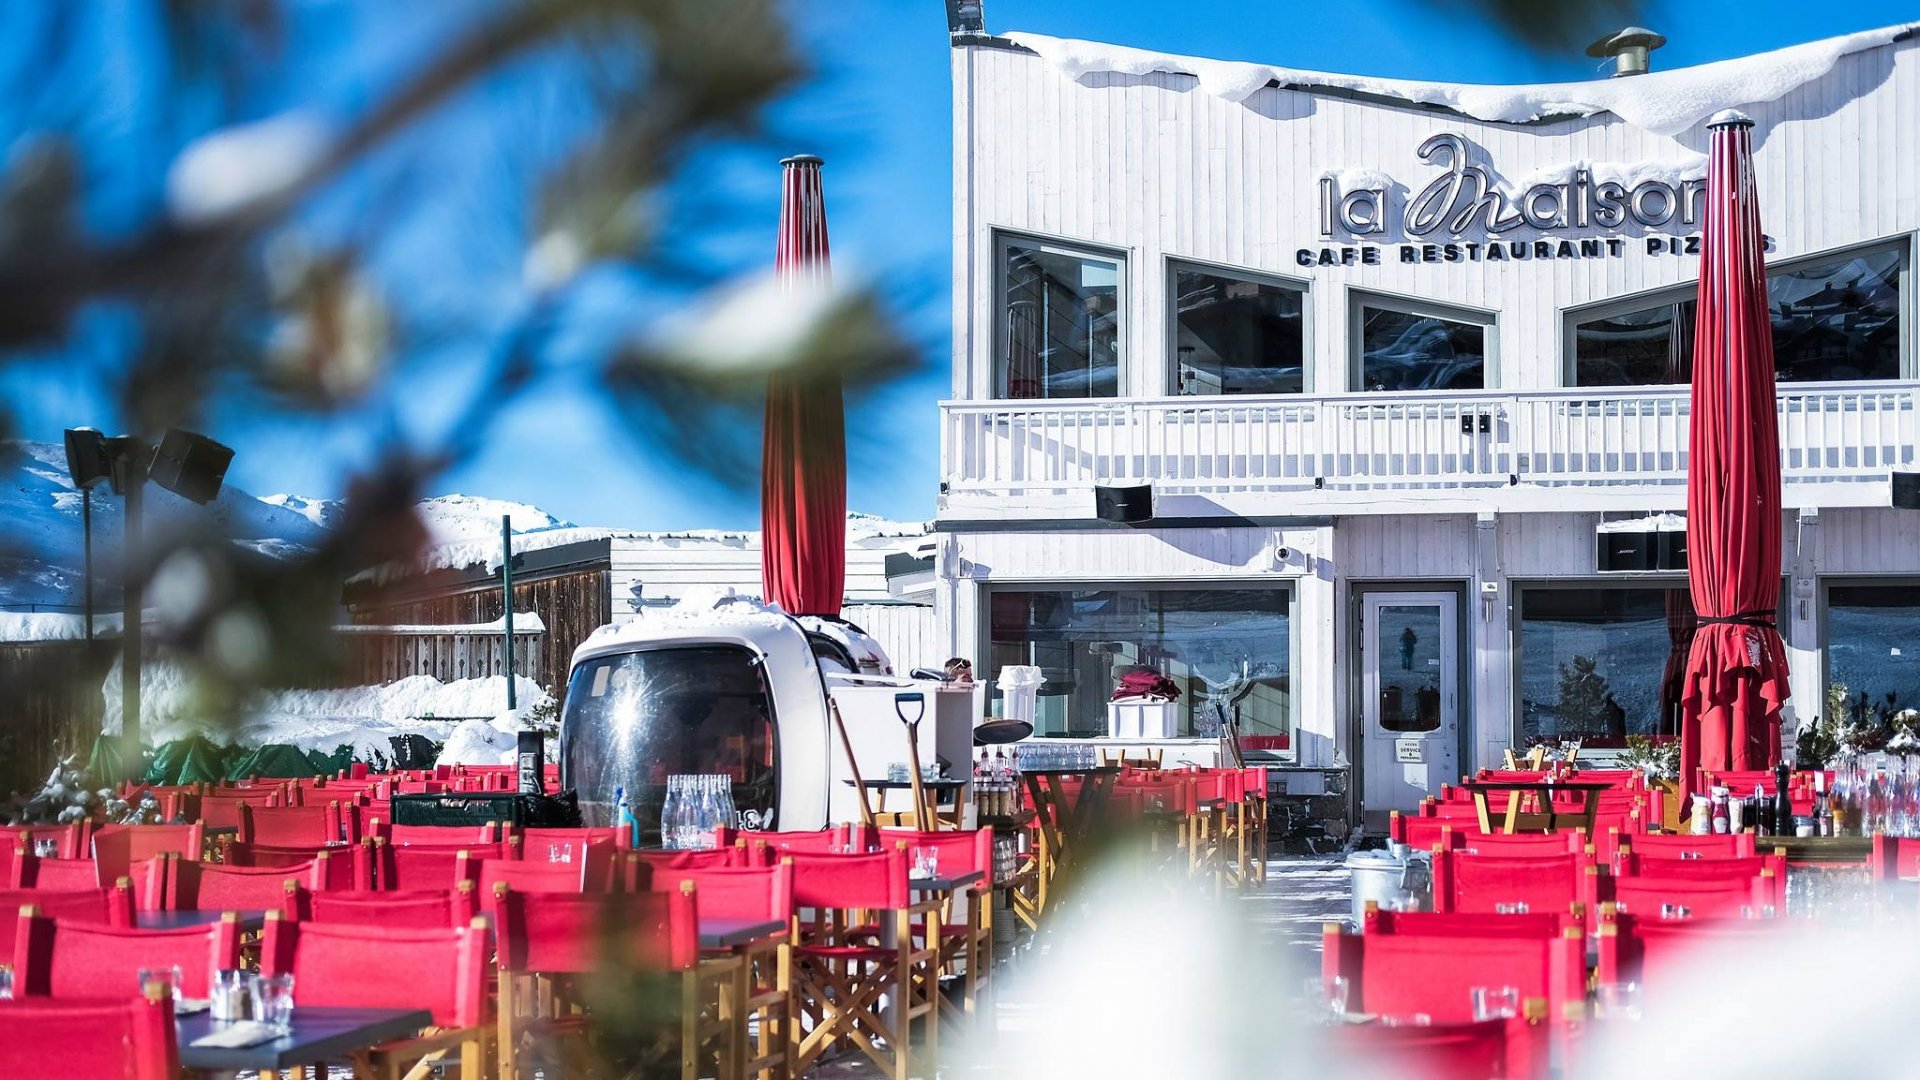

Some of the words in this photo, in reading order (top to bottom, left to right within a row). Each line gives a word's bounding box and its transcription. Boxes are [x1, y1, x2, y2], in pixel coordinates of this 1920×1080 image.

[1320, 178, 1385, 235] la
[1296, 246, 1376, 266] CAFE
[1400, 239, 1621, 263] RESTAURANT
[1646, 234, 1770, 255] PIZS
